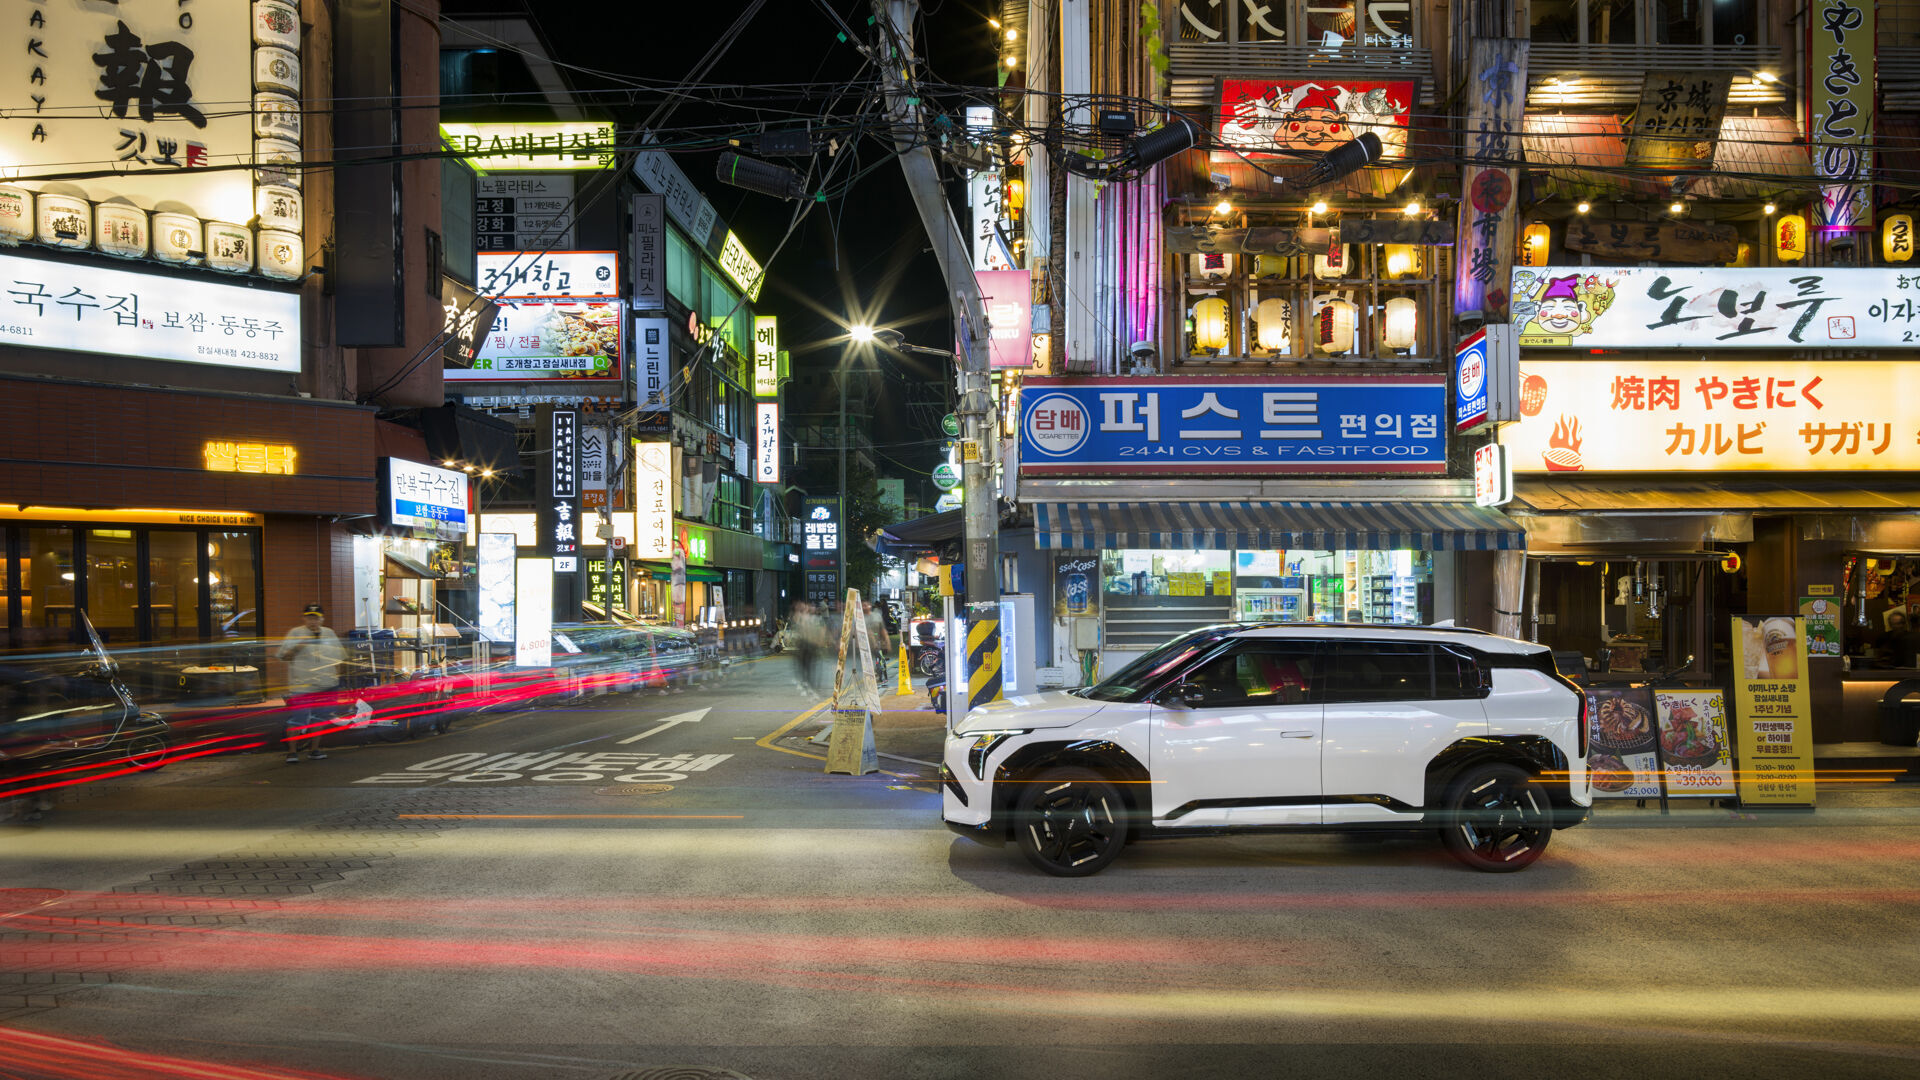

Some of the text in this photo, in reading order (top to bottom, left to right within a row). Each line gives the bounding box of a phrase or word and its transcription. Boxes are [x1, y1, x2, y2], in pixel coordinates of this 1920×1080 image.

[1656, 80, 1713, 115] 京城
[1645, 116, 1713, 134] 야시장
[477, 180, 547, 194] 노필라테스
[1892, 220, 1909, 253] うどん
[481, 260, 609, 294] 조개창고 3F
[7, 280, 139, 329] 국수집
[1646, 275, 1843, 344] 노보루
[495, 336, 507, 349] 찜
[518, 335, 542, 349] 전골
[757, 326, 776, 372] 헤라
[197, 345, 280, 362] 잠실새내점 423-8832
[505, 358, 542, 370] 조개창고
[543, 358, 587, 370] 잠실새내점
[1461, 360, 1481, 385] 담배
[757, 377, 777, 387] 바디샵
[1611, 375, 1825, 412] 焼肉 やきにく
[1034, 408, 1082, 431] 담배
[1099, 391, 1438, 443] 퍼스트 편의점
[763, 413, 776, 464] 조개창고
[1038, 432, 1080, 440] CIGARETTES
[1665, 420, 1892, 456] カルビ サガリ
[556, 417, 564, 491] IZAKAYA
[1119, 445, 1430, 456] 24시 CVS & FASTFOOD
[396, 472, 460, 505] 만복국수집
[806, 534, 837, 550] 홀덤
[559, 561, 570, 569] 2F
[588, 560, 624, 573] HEA
[592, 584, 622, 593] 스웨시
[592, 594, 622, 603] 마지
[1661, 697, 1698, 709] やきにく
[1754, 704, 1792, 714] 1주년 기념
[1709, 694, 1730, 766] 야끼니꾸
[1754, 722, 1793, 732] 기린생맥주
[351, 752, 735, 784] 일방통행
